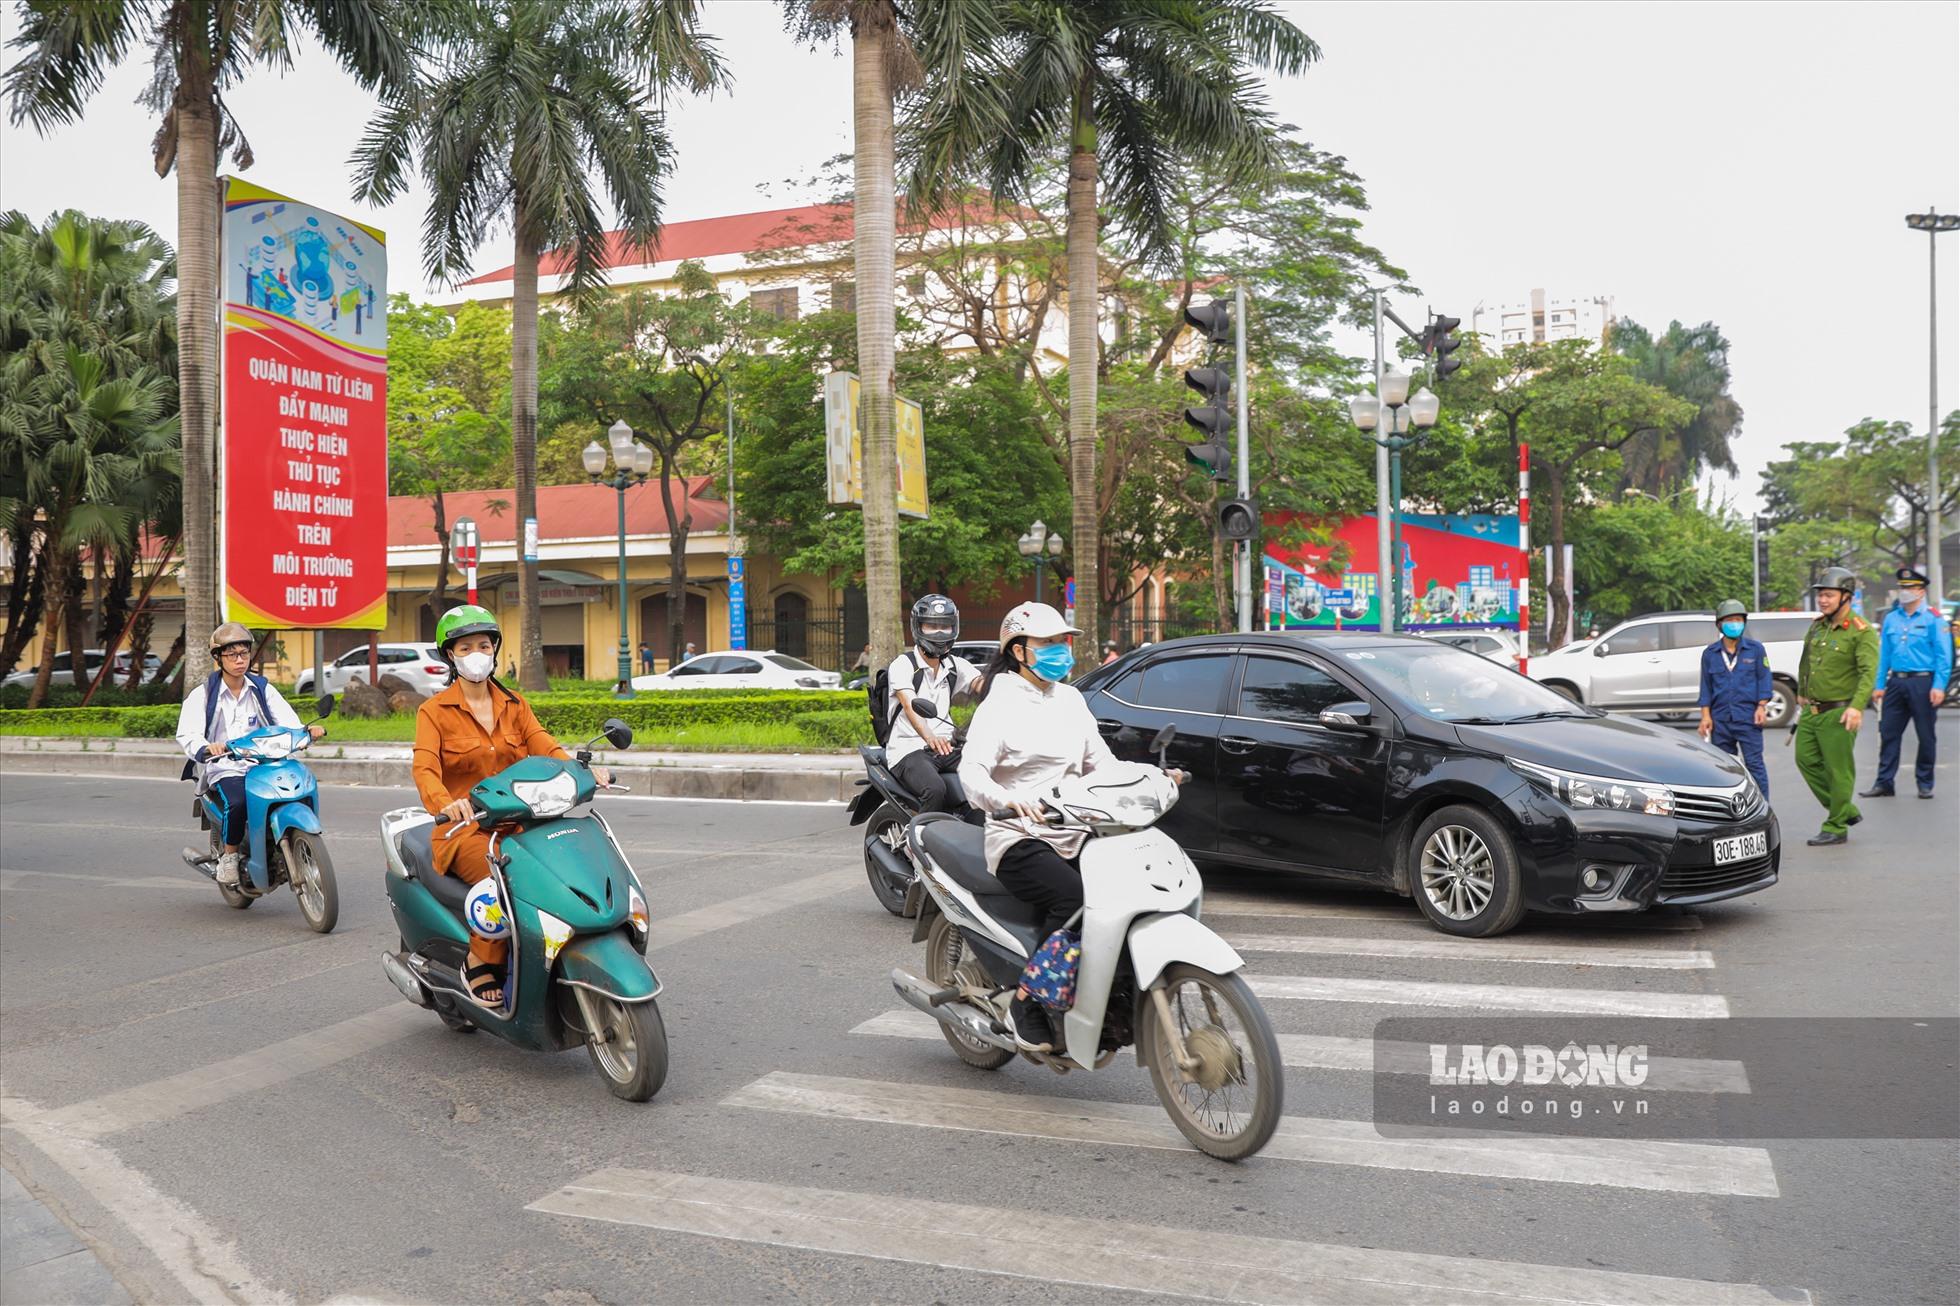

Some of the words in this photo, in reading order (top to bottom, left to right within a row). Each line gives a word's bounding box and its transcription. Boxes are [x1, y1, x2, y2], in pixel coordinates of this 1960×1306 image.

[249, 357, 288, 386] QUẬN
[291, 366, 322, 391] NAM
[325, 371, 343, 395] TỪ
[344, 377, 373, 402] LIÊM
[279, 390, 306, 419] ĐẨY
[309, 401, 348, 427] MẠNH
[280, 427, 314, 454] THỰC
[317, 432, 348, 459] HIỆN
[287, 455, 313, 483] THỦ
[316, 464, 341, 489] TỤC
[273, 487, 311, 513] HÀNH
[314, 493, 353, 518] CHÍNH
[297, 522, 331, 546] TRÊN
[272, 551, 300, 575] MÔI
[303, 553, 353, 578] TRƯỜNG
[285, 583, 317, 611] ĐIỆN
[320, 580, 338, 607] TỬ
[546, 828, 579, 840] HONDA
